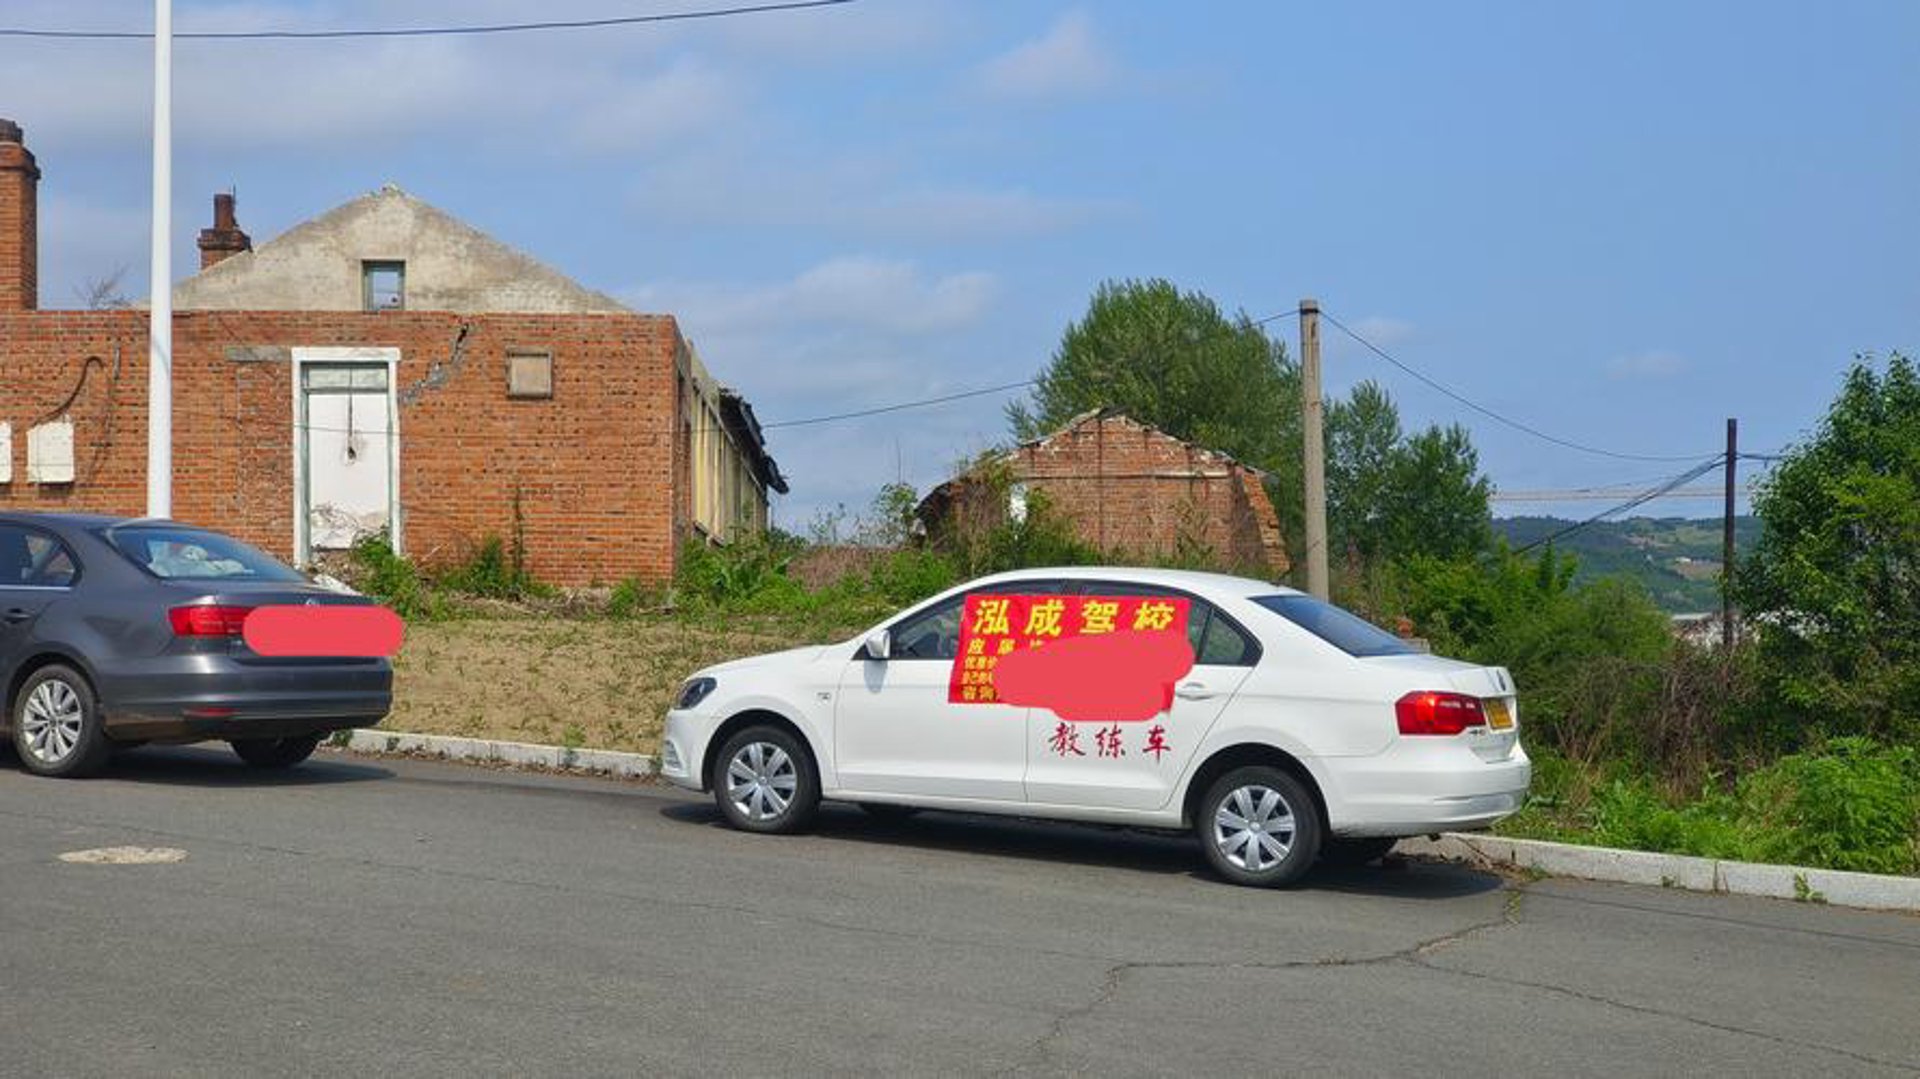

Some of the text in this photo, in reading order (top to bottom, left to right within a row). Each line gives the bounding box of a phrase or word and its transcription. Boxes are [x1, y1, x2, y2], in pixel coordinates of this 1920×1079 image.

[973, 599, 1175, 634] 泓成驾校
[961, 685, 1000, 701] 咨询
[1048, 721, 1172, 763] 教练车
